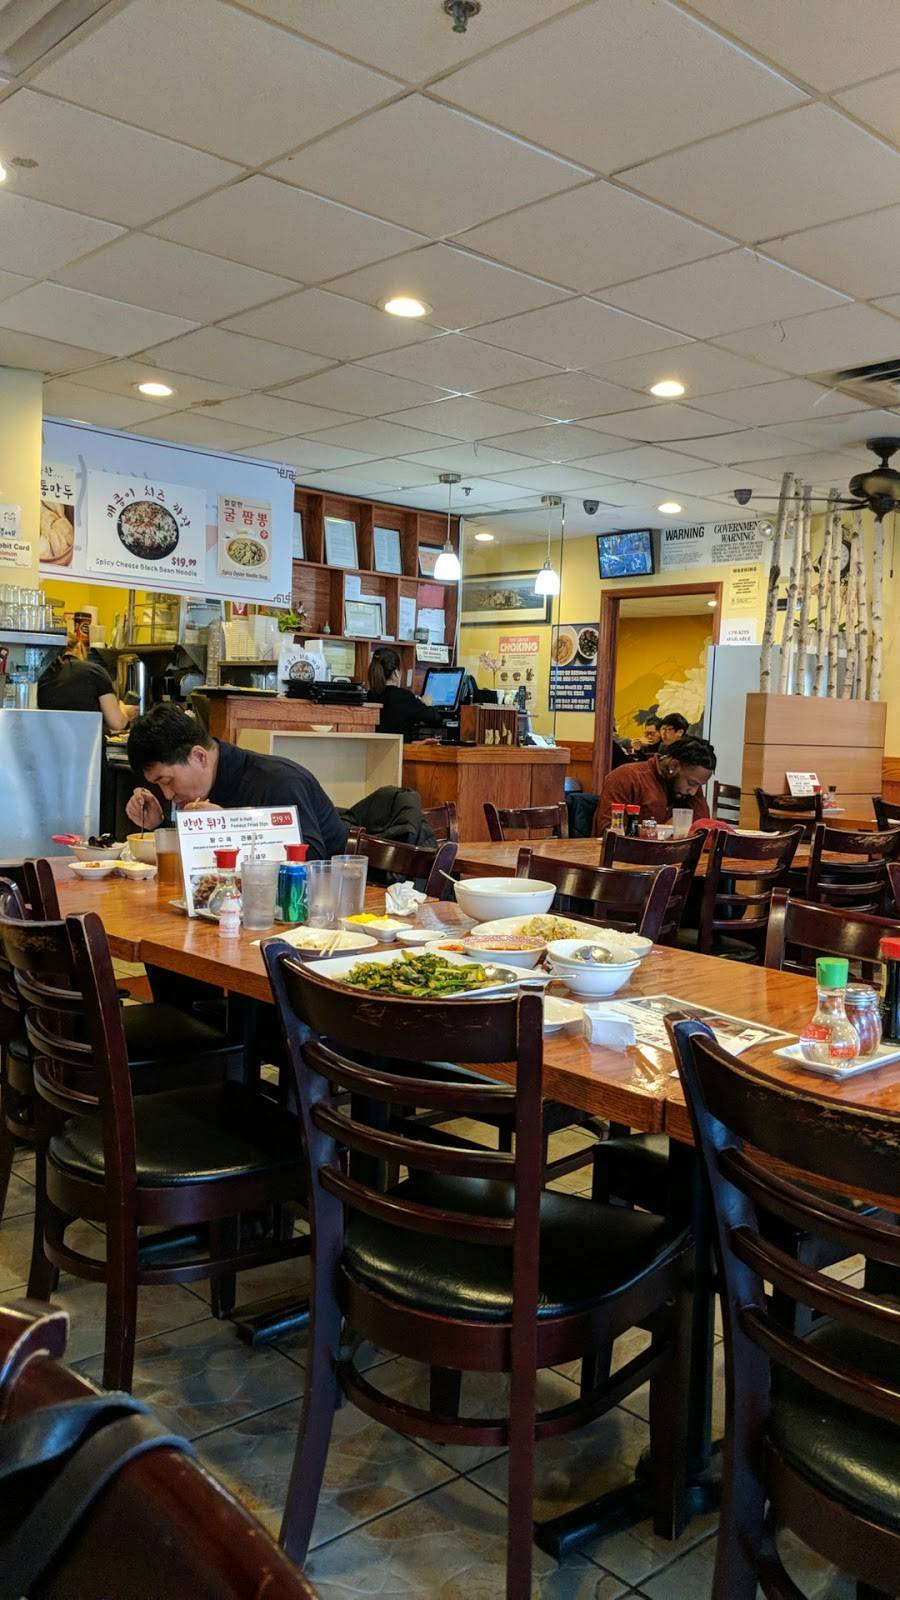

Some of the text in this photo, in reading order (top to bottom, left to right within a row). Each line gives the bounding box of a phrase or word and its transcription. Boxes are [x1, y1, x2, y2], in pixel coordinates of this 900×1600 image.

[144, 485, 165, 502] 치즈
[173, 502, 191, 528] 짜장
[224, 508, 268, 528] 굴 짬뽕
[665, 526, 705, 541] WARNING
[713, 520, 761, 534] GOVERNMEN
[96, 557, 197, 577] Spicy Cheese Black Bean Noodle
[171, 556, 197, 568] $19.99
[500, 641, 538, 652] CHOKING
[183, 816, 226, 830] 반반 튀김
